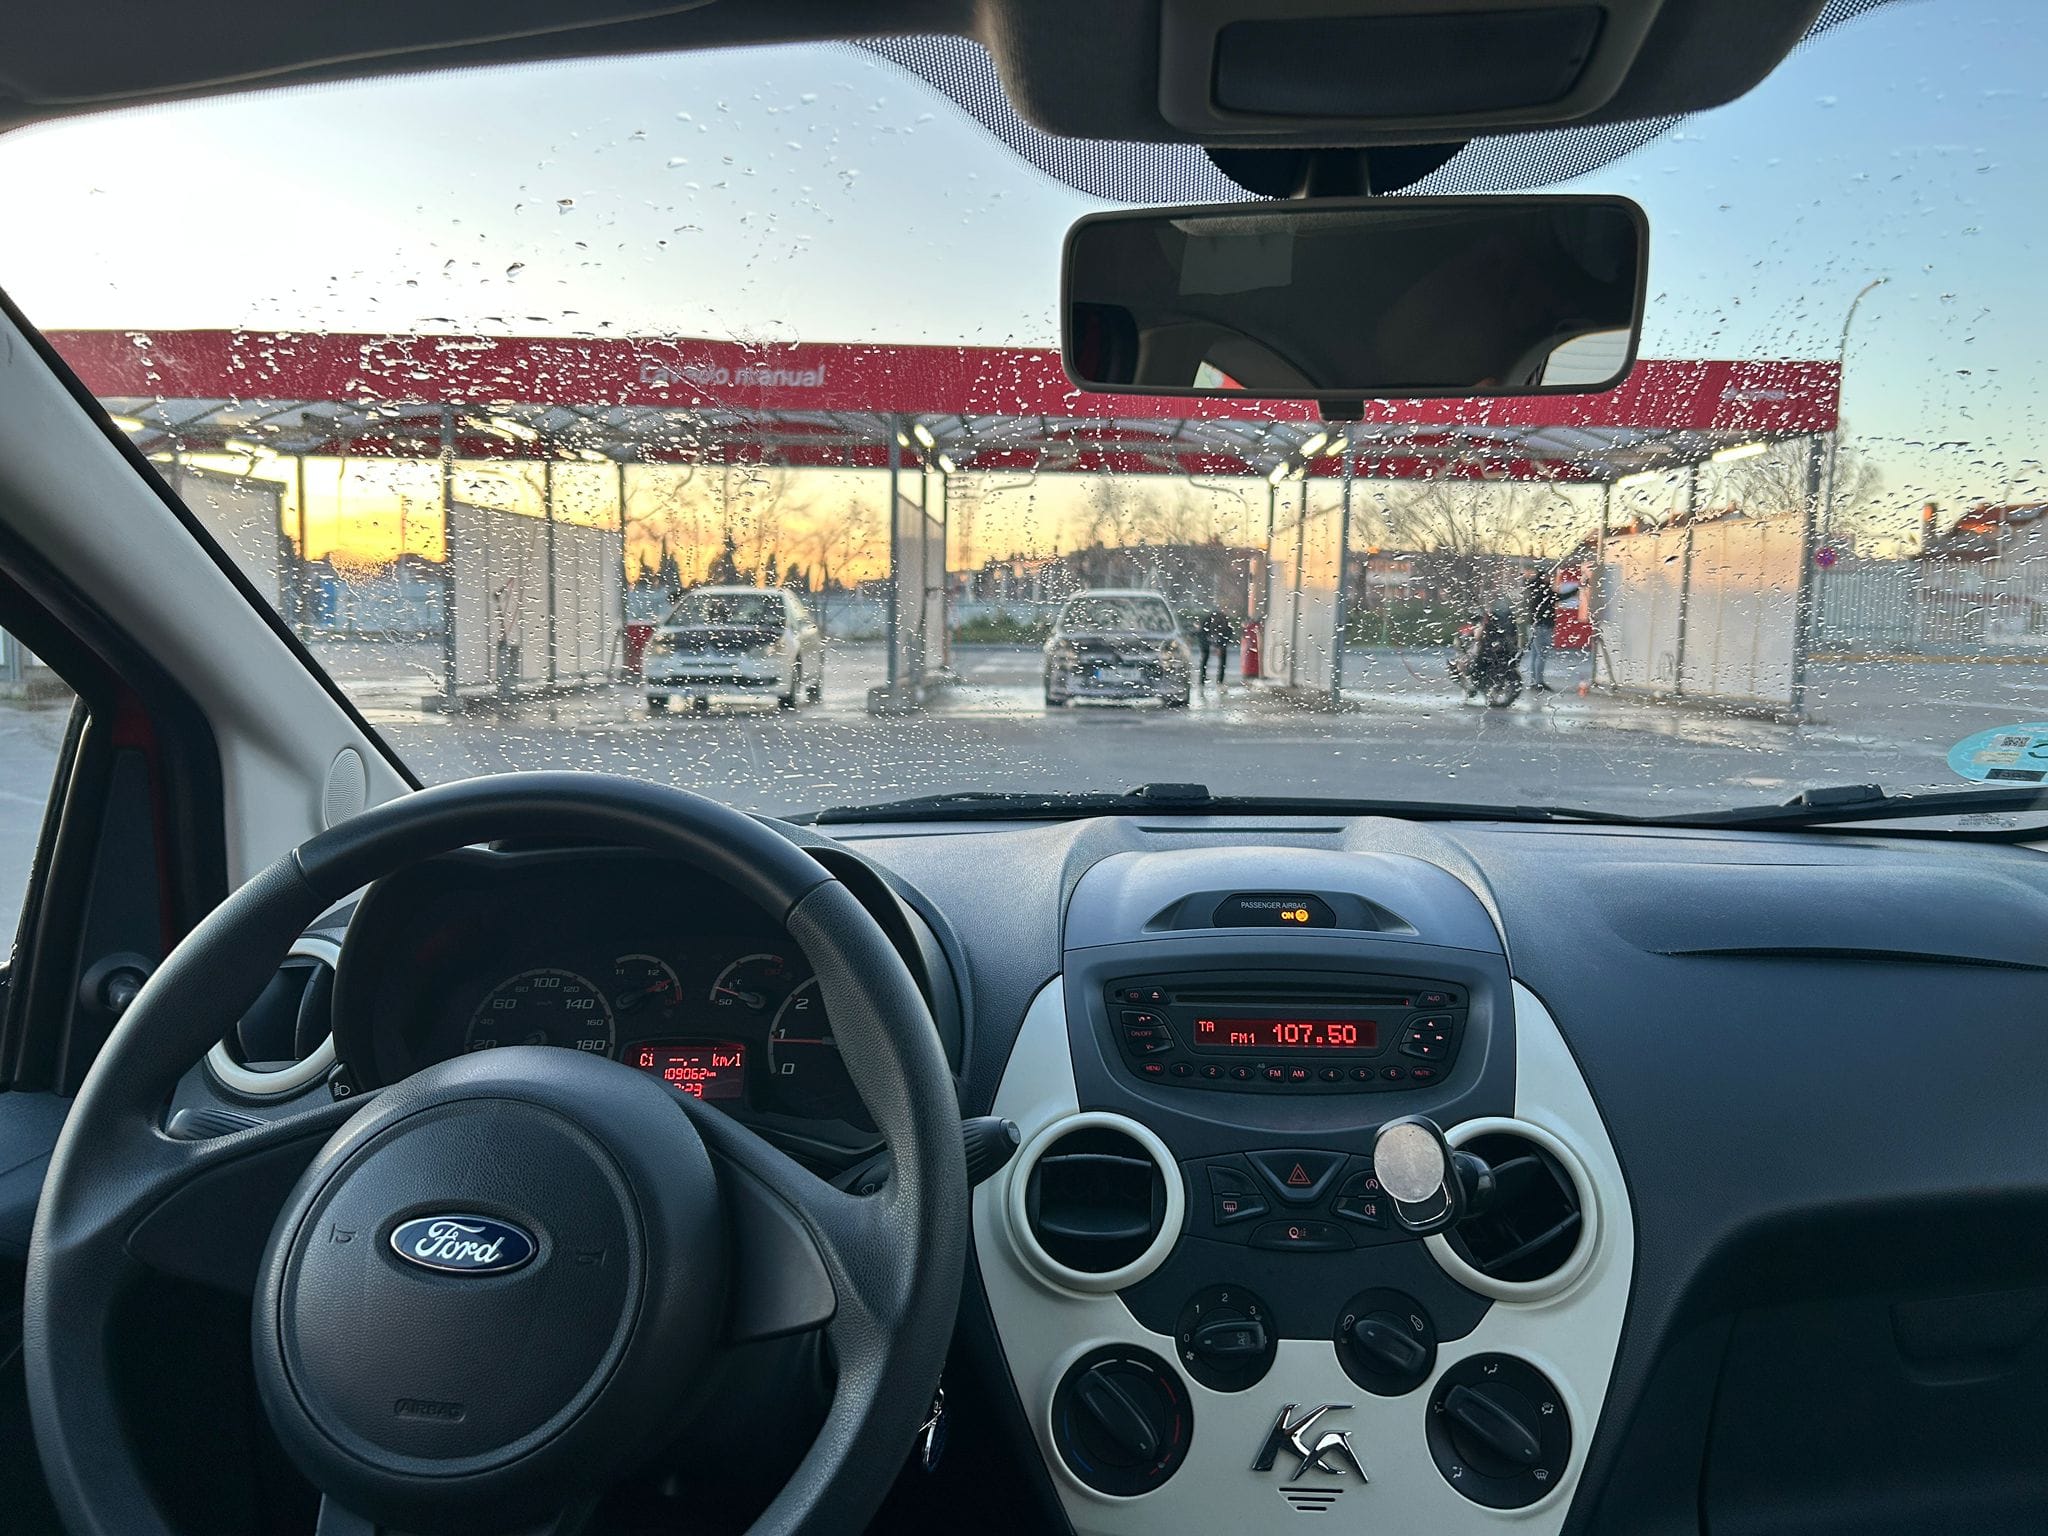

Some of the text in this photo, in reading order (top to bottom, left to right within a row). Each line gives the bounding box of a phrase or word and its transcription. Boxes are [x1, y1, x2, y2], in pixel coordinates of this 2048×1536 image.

[735, 364, 826, 387] manual
[1240, 901, 1280, 909] PASSENGER
[1281, 911, 1295, 919] ON
[533, 977, 560, 988] 100
[492, 999, 517, 1009] 60
[565, 999, 594, 1009] 140
[795, 998, 809, 1010] 2
[1198, 1021, 1215, 1032] TA
[779, 1028, 786, 1039] 1
[1230, 1023, 1357, 1044] FM1 107.50
[473, 1039, 497, 1050] 20
[576, 1039, 606, 1051] 180
[639, 1053, 654, 1067] Ci
[712, 1053, 741, 1067] km/l
[781, 1063, 795, 1075] 0
[1209, 1068, 1216, 1076] 2
[1239, 1069, 1246, 1077] 3
[1269, 1069, 1281, 1077] FM
[1291, 1070, 1305, 1078] AM
[1328, 1070, 1334, 1078] 4
[1359, 1070, 1366, 1078] 5
[1390, 1069, 1397, 1077] 6
[415, 1220, 506, 1264] Ford
[1221, 1292, 1229, 1302] 2
[1195, 1304, 1200, 1314] 1
[1249, 1305, 1256, 1315] 3
[1183, 1333, 1190, 1343] 0
